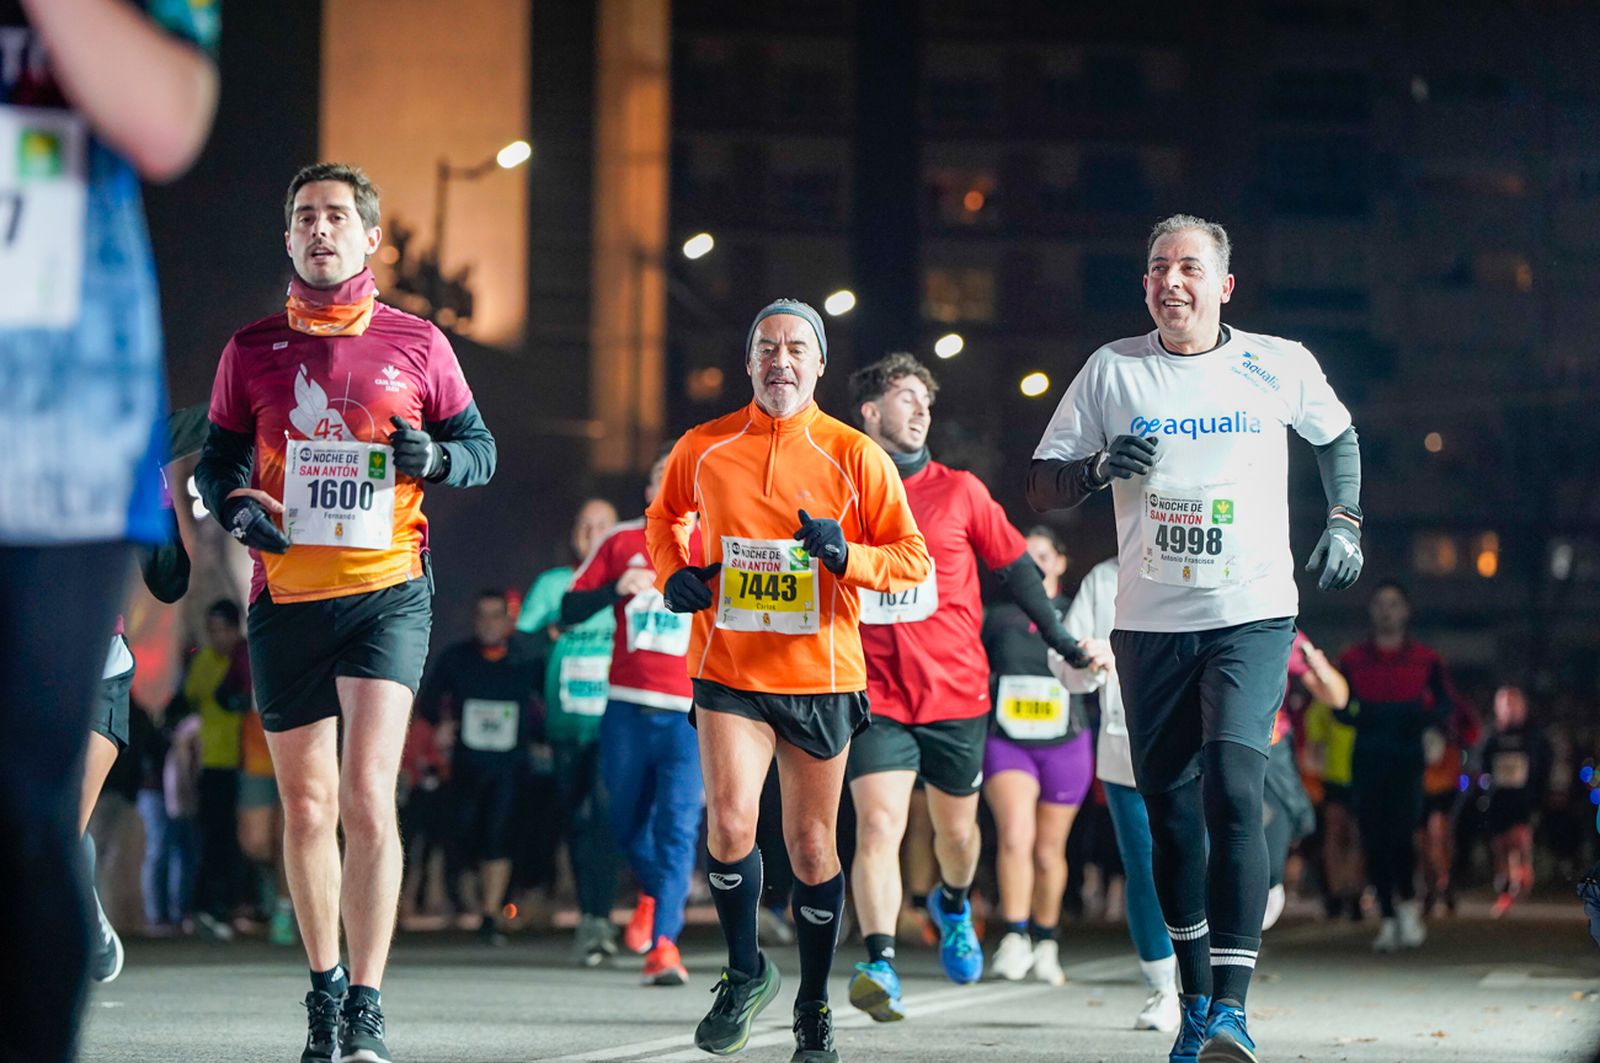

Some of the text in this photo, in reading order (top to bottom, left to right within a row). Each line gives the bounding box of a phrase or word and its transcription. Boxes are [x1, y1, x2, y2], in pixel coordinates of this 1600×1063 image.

[1242, 360, 1281, 391] aqualia
[312, 453, 359, 464] NOCHE DE
[299, 465, 320, 477] SAN
[321, 464, 359, 477] ANTÓN
[307, 479, 374, 511] 1600
[1158, 501, 1203, 512] NOCHE DE
[323, 512, 355, 520] Fernando
[1150, 510, 1167, 522] SAN
[1167, 512, 1203, 525] ANTÓN
[1155, 524, 1223, 556] 4998
[741, 548, 768, 560] NOCHE
[769, 550, 781, 560] DE
[1160, 554, 1214, 565] Antonio Francisco
[731, 558, 747, 569] SAN
[739, 571, 797, 602] 7443
[756, 602, 776, 610] Carlos
